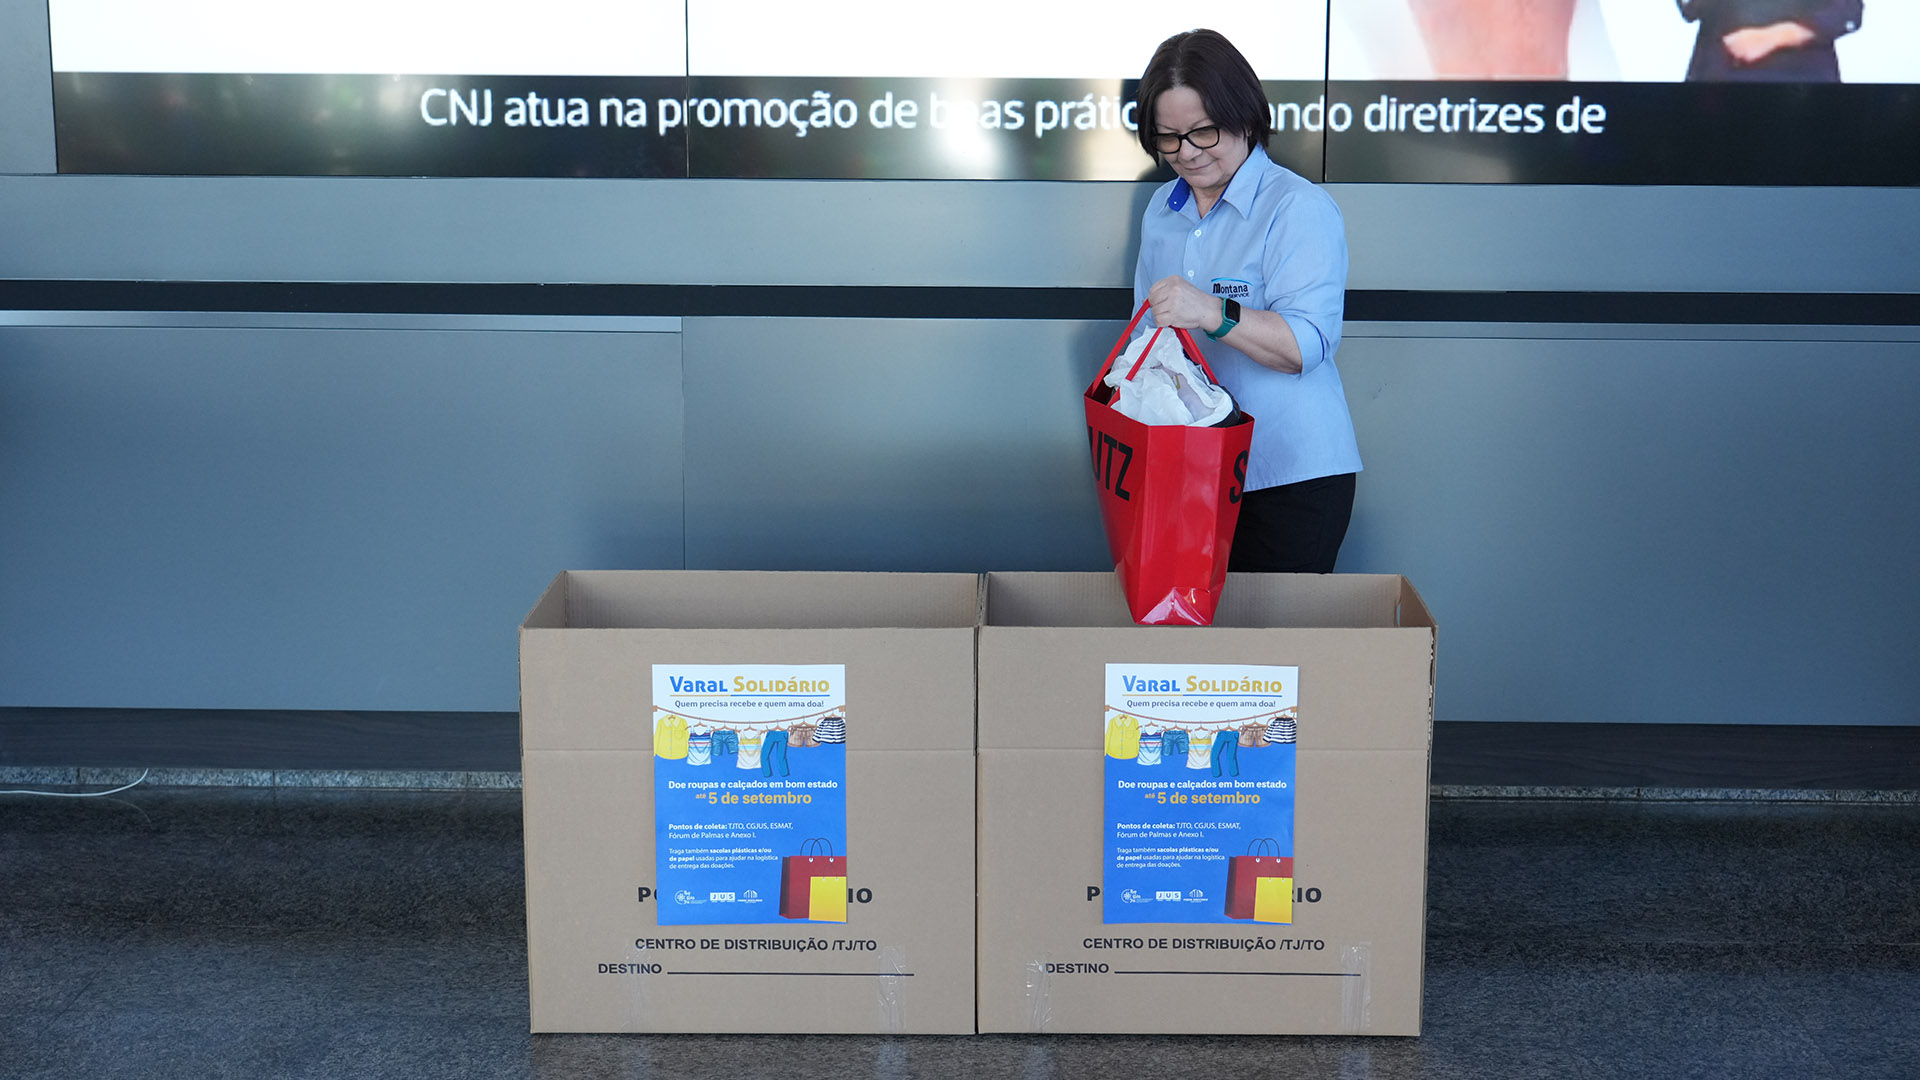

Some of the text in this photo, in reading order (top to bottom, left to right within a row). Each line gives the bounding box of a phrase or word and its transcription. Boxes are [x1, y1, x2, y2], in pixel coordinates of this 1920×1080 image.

[420, 88, 492, 127] CNJ
[503, 92, 590, 128] atua
[599, 97, 647, 128] na
[659, 91, 857, 136] promoção
[869, 92, 918, 129] de
[1036, 93, 1138, 138] prátic
[1363, 94, 1544, 134] diretrizes
[1555, 95, 1607, 135] de
[1212, 283, 1248, 294] Montana
[675, 700, 698, 708] Quem
[699, 700, 728, 709] precisa
[730, 700, 757, 708] recebe
[806, 700, 824, 708] doa!
[1127, 700, 1150, 708] Quem
[1151, 700, 1180, 709] precisa
[1181, 700, 1208, 708] recebe
[1259, 700, 1276, 708] doa!
[668, 781, 686, 789] Doe
[687, 782, 719, 791] roupas
[727, 780, 768, 791] calçados
[785, 781, 806, 789] bom
[807, 781, 838, 789] estado
[1118, 781, 1136, 789] Doe
[1137, 782, 1169, 791] roupas
[1177, 780, 1217, 791] calçados
[1234, 781, 1255, 789] bom
[1256, 781, 1287, 789] estado
[708, 792, 717, 804] 5
[721, 792, 739, 804] de
[742, 791, 812, 804] setembro
[1157, 792, 1166, 804] 5
[1170, 792, 1188, 804] de
[1191, 791, 1260, 804] setembro
[746, 822, 769, 830] CGJUS,
[770, 822, 794, 830] ESMAT,
[1218, 822, 1241, 830] ESMAT,
[635, 937, 877, 952] CENTRO DE DISTRIBUIÇÃO /TJ/TO
[1083, 936, 1324, 952] CENTRO DE DISTRIBUIÇÃO /TJ/TO
[598, 963, 662, 974] DESTINO
[1045, 963, 1109, 974] DESTINO
